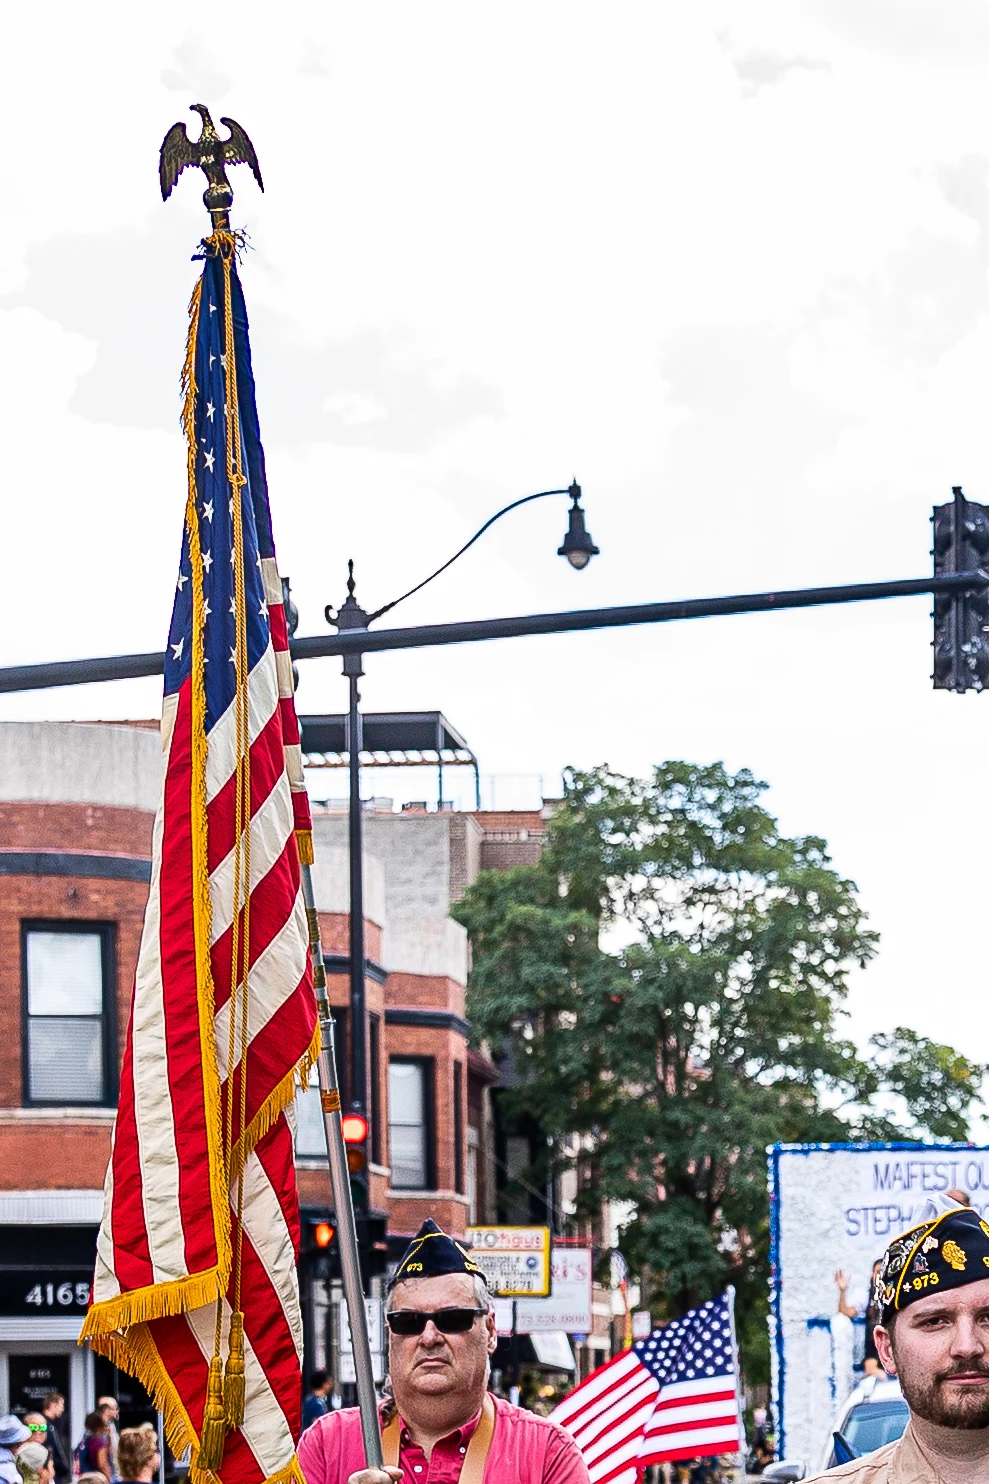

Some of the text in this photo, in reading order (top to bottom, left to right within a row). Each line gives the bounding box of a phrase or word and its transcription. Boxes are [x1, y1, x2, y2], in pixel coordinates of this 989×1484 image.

[873, 1161, 957, 1191] MAIFEST
[912, 1271, 940, 1291] 973
[25, 1282, 90, 1306] 4165
